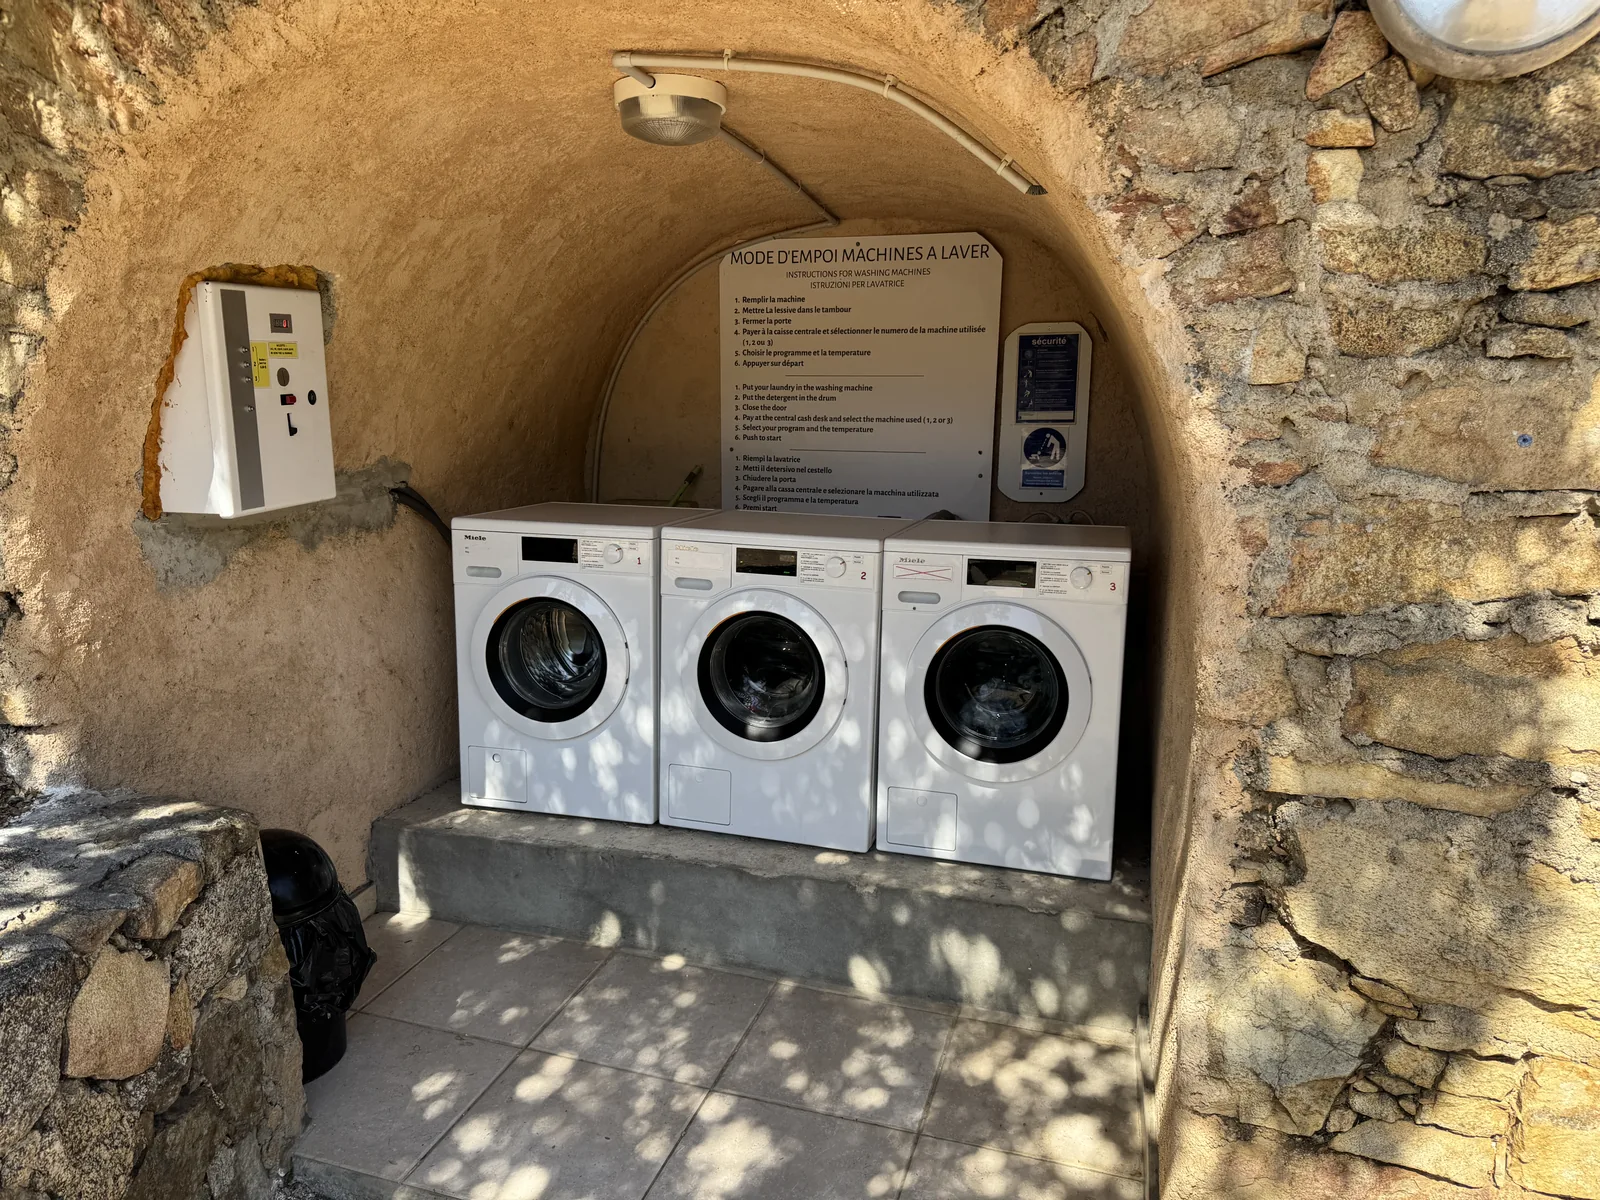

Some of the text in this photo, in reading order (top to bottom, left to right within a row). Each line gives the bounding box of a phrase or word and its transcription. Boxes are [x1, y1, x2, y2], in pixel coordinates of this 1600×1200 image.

[730, 244, 990, 264] MODE D'EMPOI MACHINES A LAVER
[786, 270, 838, 278] INSTRUCTIONS
[867, 280, 904, 288] LAVATRICE
[1032, 337, 1066, 346] sécurité
[861, 572, 867, 580] 2
[1110, 582, 1116, 591] 3
